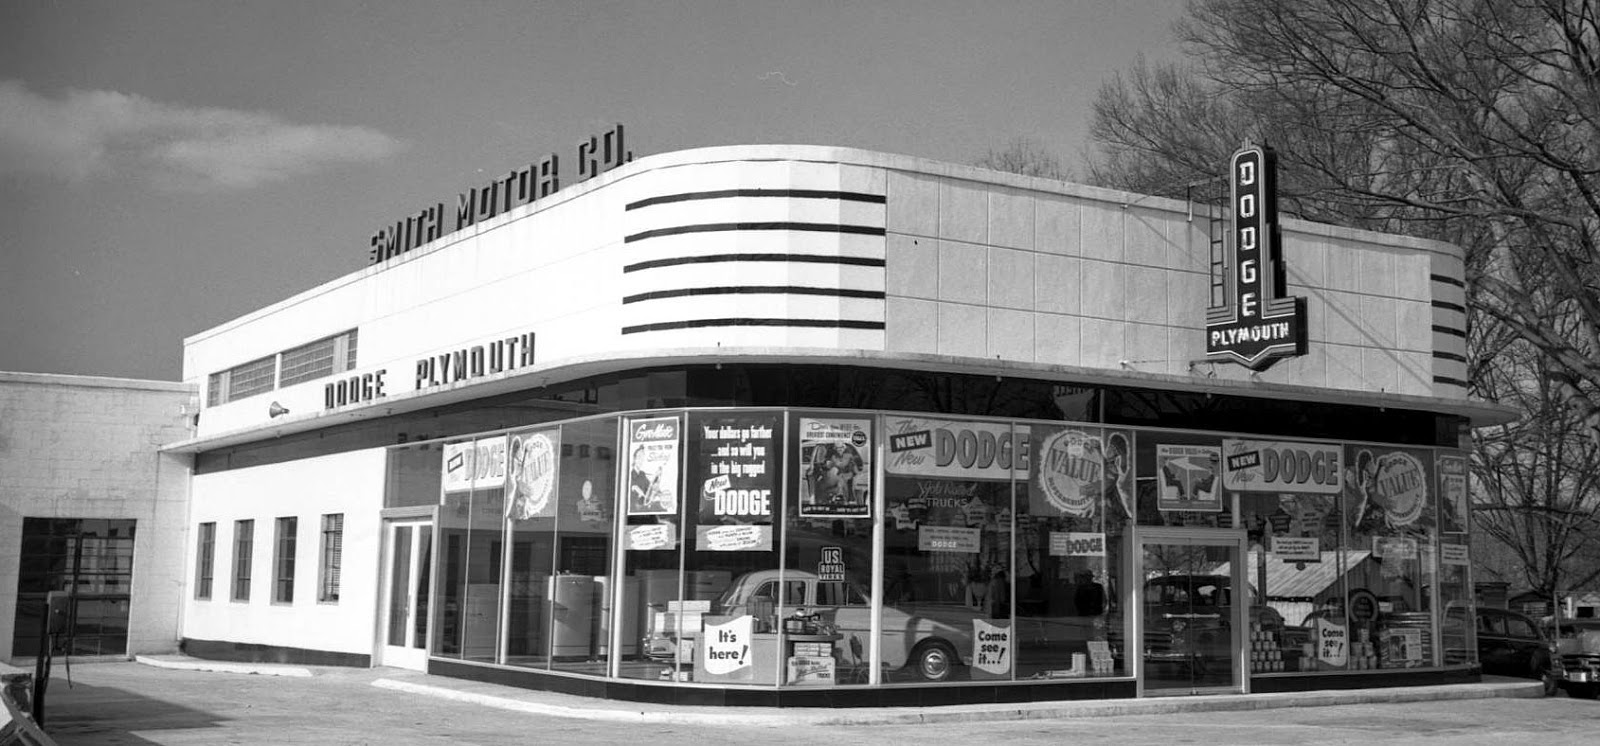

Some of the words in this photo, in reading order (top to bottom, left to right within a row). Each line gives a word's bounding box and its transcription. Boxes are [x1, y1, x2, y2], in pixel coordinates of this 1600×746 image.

[370, 203, 444, 264] SMITH
[457, 152, 559, 231] MOTOR
[578, 122, 632, 184] CO.
[1239, 161, 1257, 317] DODGE
[1211, 322, 1289, 347] PLYMOUTH
[325, 369, 387, 409] DODGE
[416, 332, 535, 390] PLYMOUTH
[703, 425, 718, 439] Your
[719, 425, 740, 439] dollars
[741, 429, 750, 443] go
[750, 425, 773, 439] farther
[895, 434, 927, 449] NEW
[730, 447, 739, 456] so
[739, 442, 752, 456] will
[752, 446, 766, 460] you
[935, 428, 1029, 471] DODGE
[711, 461, 718, 474] in
[718, 460, 730, 474] the
[731, 460, 741, 478] big
[742, 460, 765, 478] rugged
[1231, 453, 1256, 468] NEW
[1262, 448, 1338, 485] DODGE
[709, 478, 728, 491] New
[714, 489, 771, 516] DODGE
[926, 497, 968, 509] TRUCKS
[1066, 538, 1103, 555] DODGE
[820, 564, 843, 573] ROYAL
[718, 629, 737, 643] It's
[978, 630, 1008, 642] Come
[1322, 628, 1344, 638] Come
[709, 645, 749, 666] here!
[981, 643, 999, 653] see
